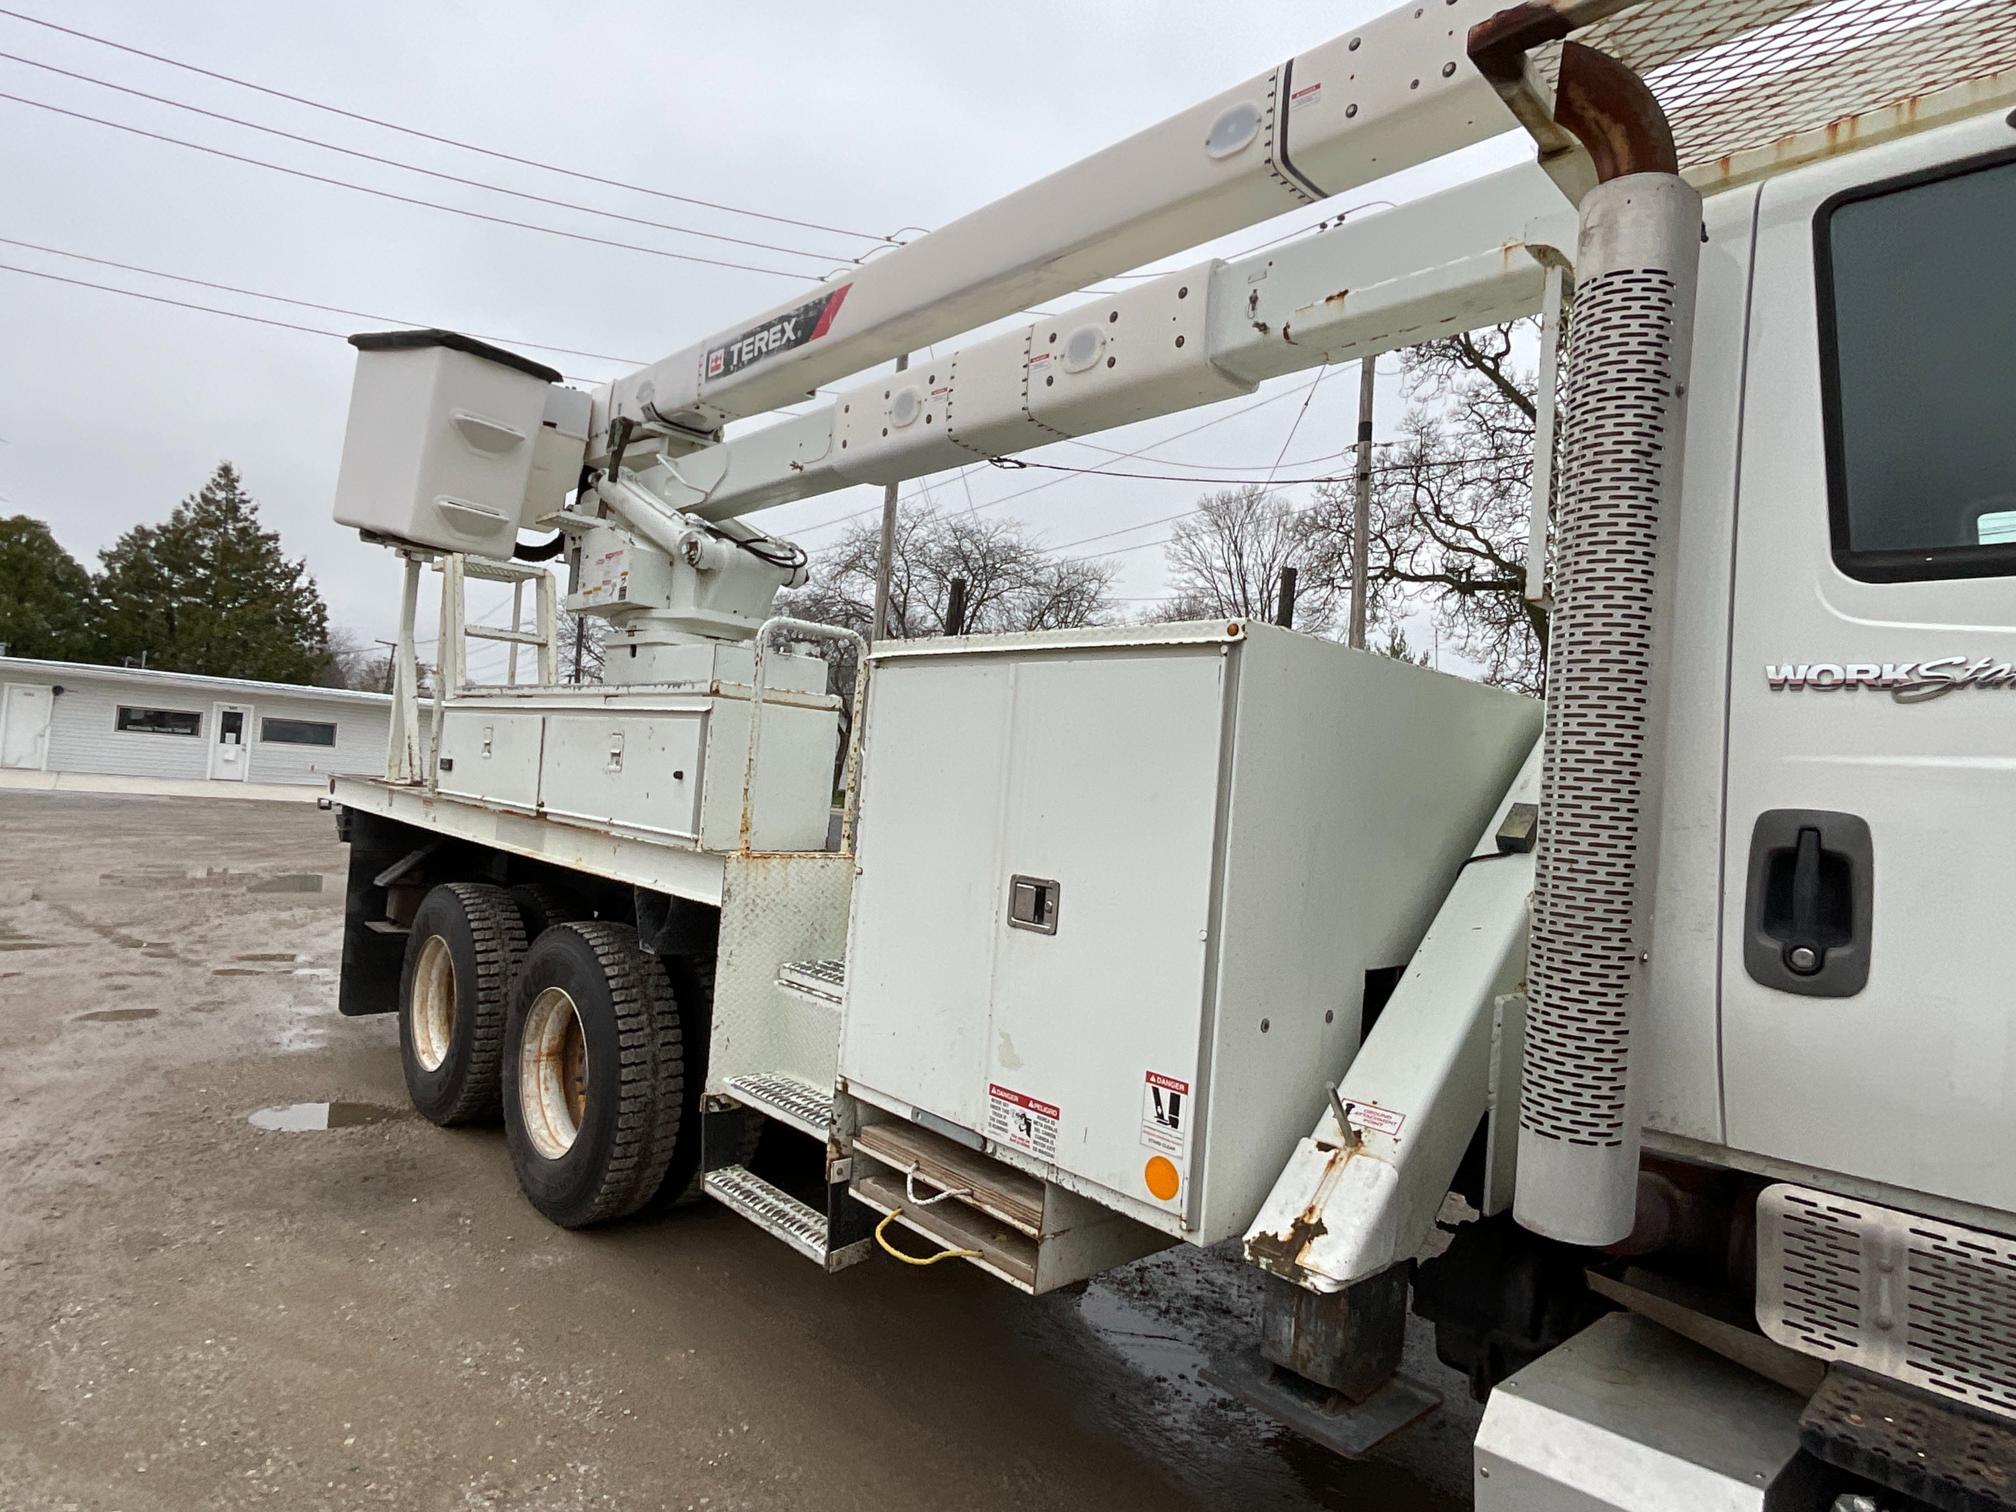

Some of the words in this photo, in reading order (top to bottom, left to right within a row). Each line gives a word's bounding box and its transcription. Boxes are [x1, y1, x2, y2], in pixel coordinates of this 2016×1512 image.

[730, 318, 797, 366] TEREX
[1156, 1076, 1185, 1092] DANGER
[997, 1088, 1019, 1102] DANGER
[1033, 1102, 1058, 1117] PELIGRO
